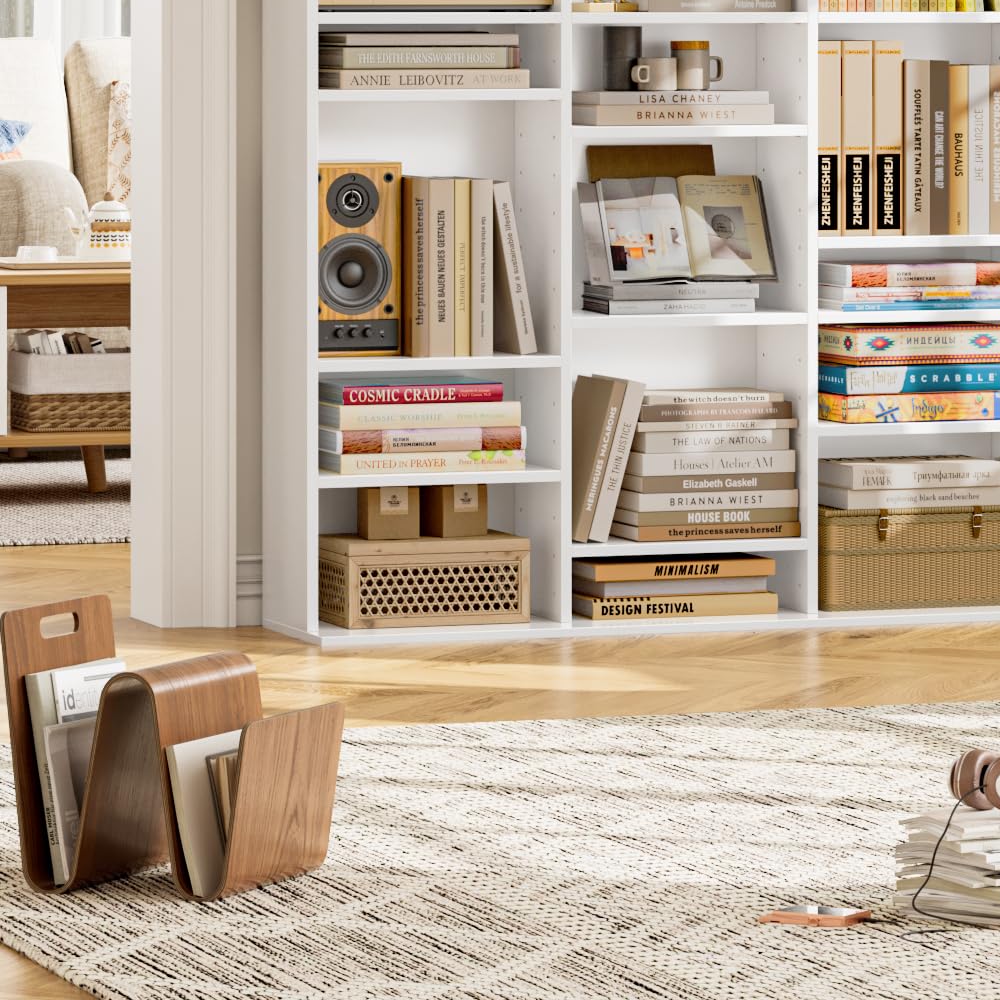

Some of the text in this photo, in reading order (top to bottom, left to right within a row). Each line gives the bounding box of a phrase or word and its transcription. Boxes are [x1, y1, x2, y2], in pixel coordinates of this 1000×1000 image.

[358, 53, 496, 64] THE EDITH FARNSWORTH HOUSE
[350, 75, 391, 86] ANNIE
[399, 74, 464, 86] LEIBOVITZ
[640, 95, 721, 103] LISA CHANEY
[914, 89, 922, 125] SOUFFLÉS
[636, 111, 736, 120] BRIANNA WIEST
[954, 133, 963, 177] BAUHAUS
[822, 157, 831, 226] ZHENFEISHEJI
[853, 157, 863, 225] ZHENFEISHEJI
[884, 157, 894, 225] ZHENFEISHEJI
[914, 178, 922, 212] GÂTEAUX
[438, 210, 446, 322] NEUES BAUEN NEUES GESTALTEN
[906, 336, 956, 345] ИНДЕЙЦЫ
[909, 373, 995, 383] SCRABBLE
[350, 388, 399, 403] COSMIC
[403, 387, 456, 402] CRADLE
[912, 398, 944, 419] Indigo
[728, 436, 767, 444] NATIONS
[356, 459, 397, 470] UNITED
[410, 458, 446, 468] PRAYER
[586, 406, 618, 512] MERINGUES MACARONS
[673, 457, 773, 470] Houses Atelier AM
[683, 478, 757, 488] Elizabeth Gaskell
[670, 496, 763, 506] BRIANNA WIEST
[688, 510, 750, 523] HOUSE BOOK
[654, 564, 720, 577] MINIMALISM
[601, 603, 694, 616] DESIGN FESTIVAL
